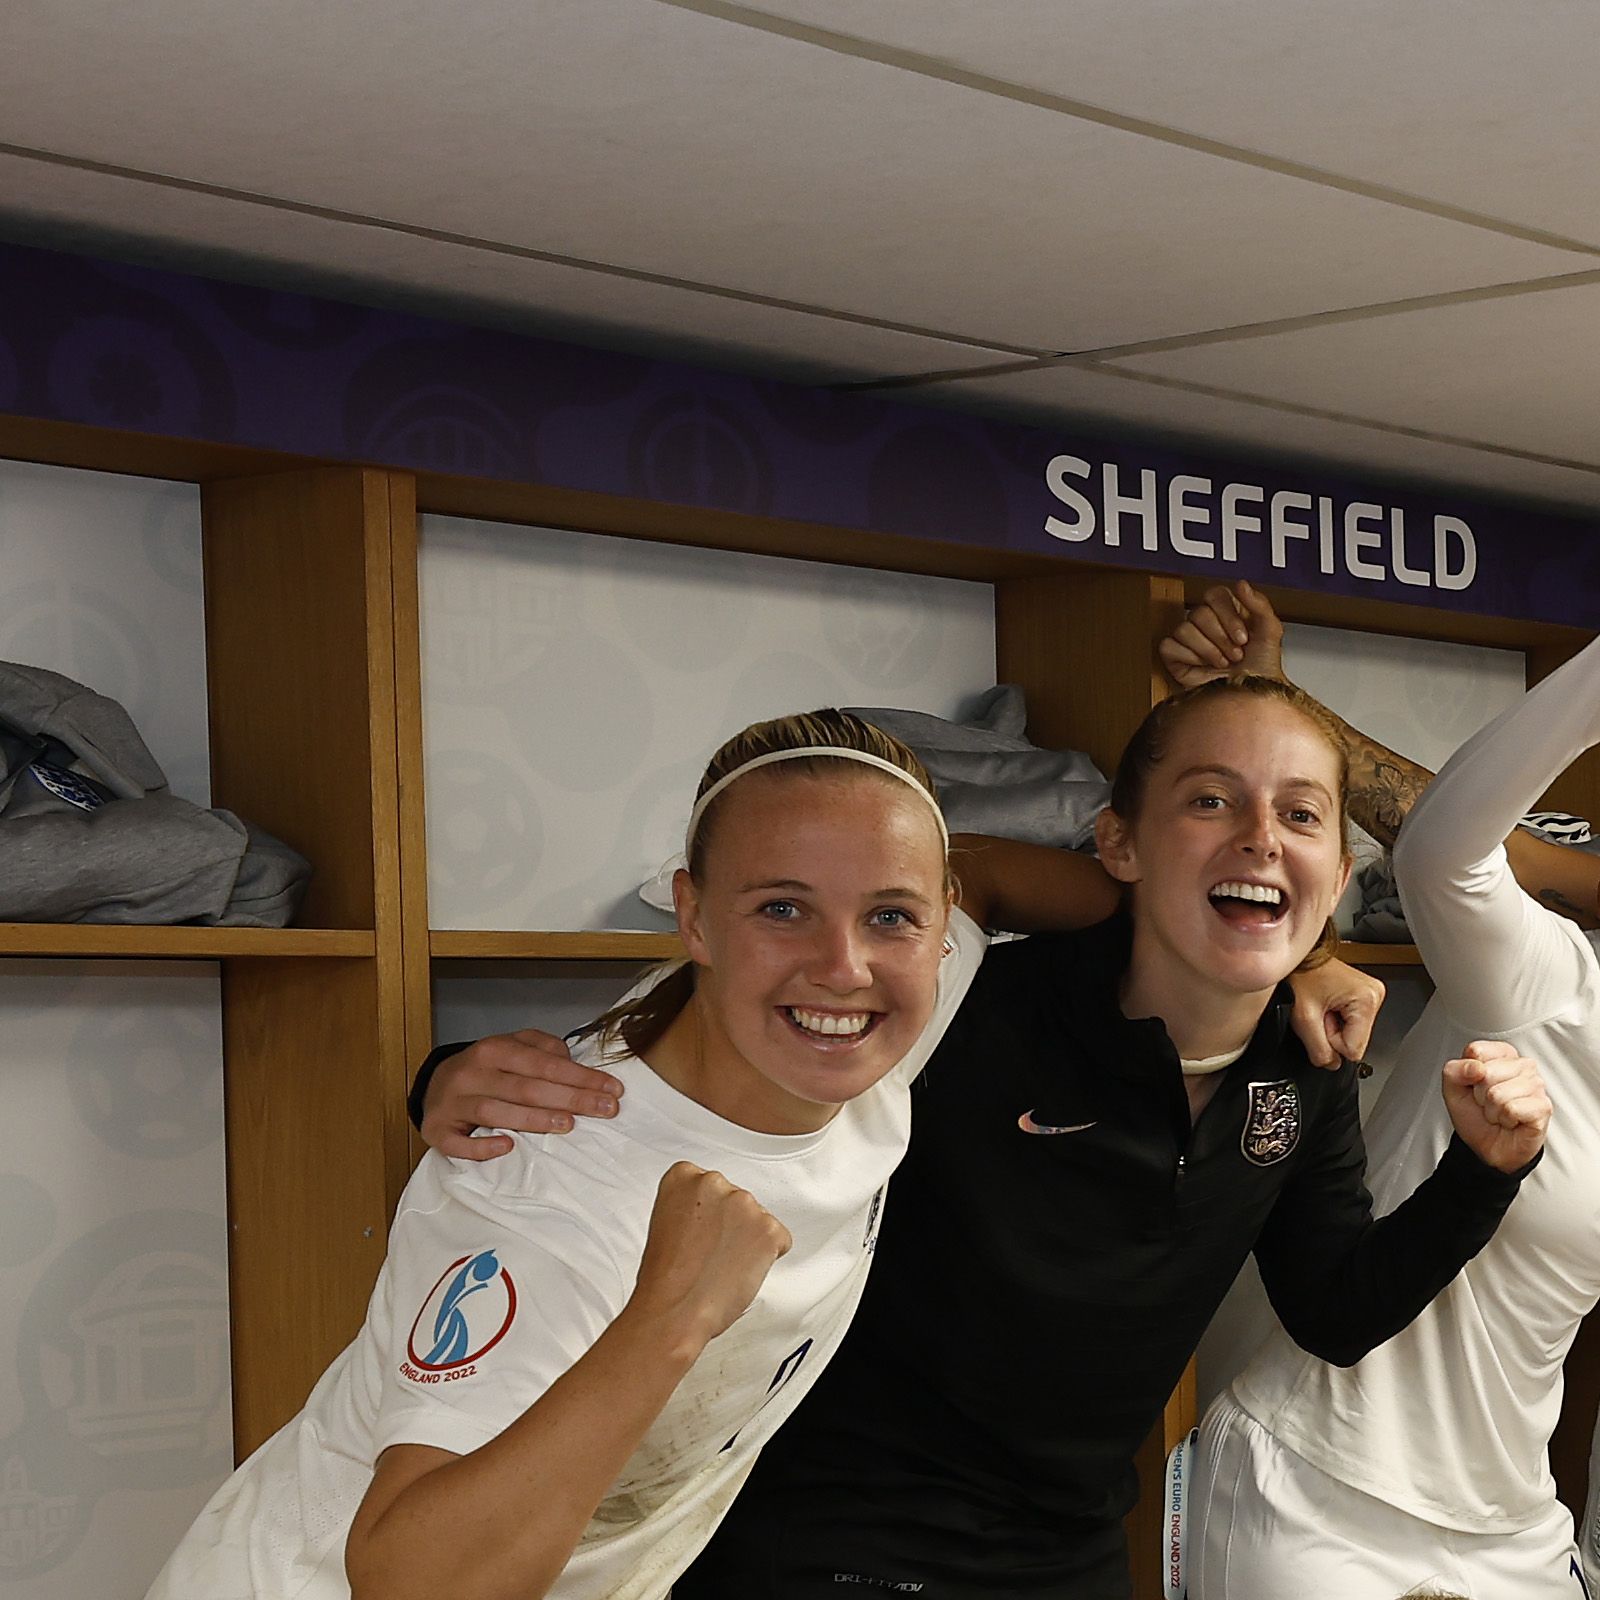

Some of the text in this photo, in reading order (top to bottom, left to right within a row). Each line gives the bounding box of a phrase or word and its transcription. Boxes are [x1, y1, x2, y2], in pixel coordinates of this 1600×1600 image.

[1044, 454, 1477, 591] SHEFFIELD
[398, 1362, 478, 1384] ENGLAND 2022
[1171, 1482, 1182, 1512] EURO
[1170, 1513, 1181, 1563] ENGLAND
[1170, 1565, 1181, 1589] 2022
